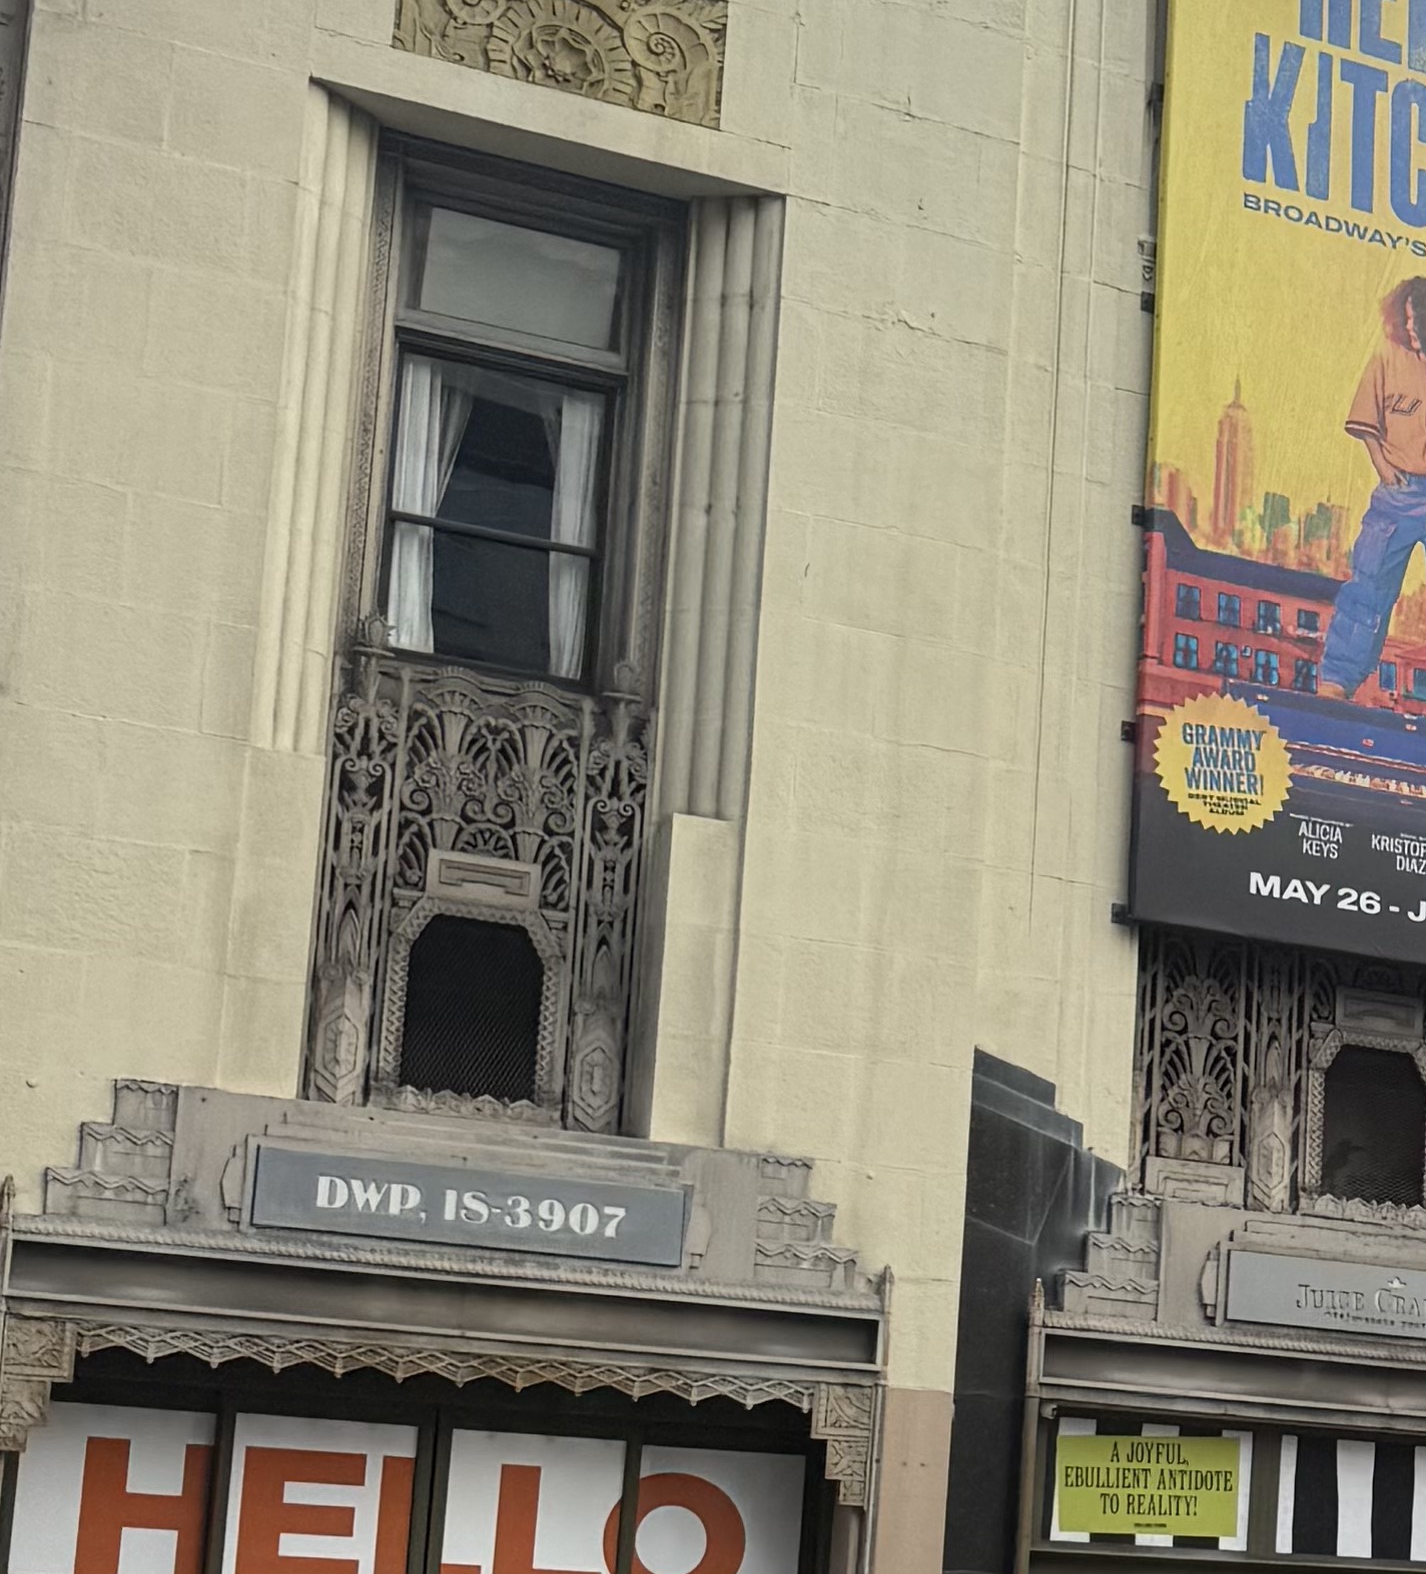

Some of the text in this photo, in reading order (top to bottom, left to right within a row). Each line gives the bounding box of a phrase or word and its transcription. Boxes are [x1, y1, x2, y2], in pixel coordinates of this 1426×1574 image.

[1182, 722, 1266, 752] GRAMMY
[1192, 746, 1256, 773] AWARD
[1184, 767, 1264, 796] WINNER!
[1298, 820, 1342, 843] ALICIA
[1302, 838, 1338, 860] KEYS
[1396, 855, 1426, 875] DIAZ
[1249, 872, 1331, 905] MAY
[1336, 887, 1381, 914] 26
[442, 1189, 627, 1238] IS-3907
[1296, 1284, 1365, 1311] JUICE
[1110, 1441, 1189, 1466] A JOYFUL,
[1064, 1466, 1233, 1492] EBULLIENT ANTIDOTE
[1100, 1493, 1198, 1517] TO REALITY!
